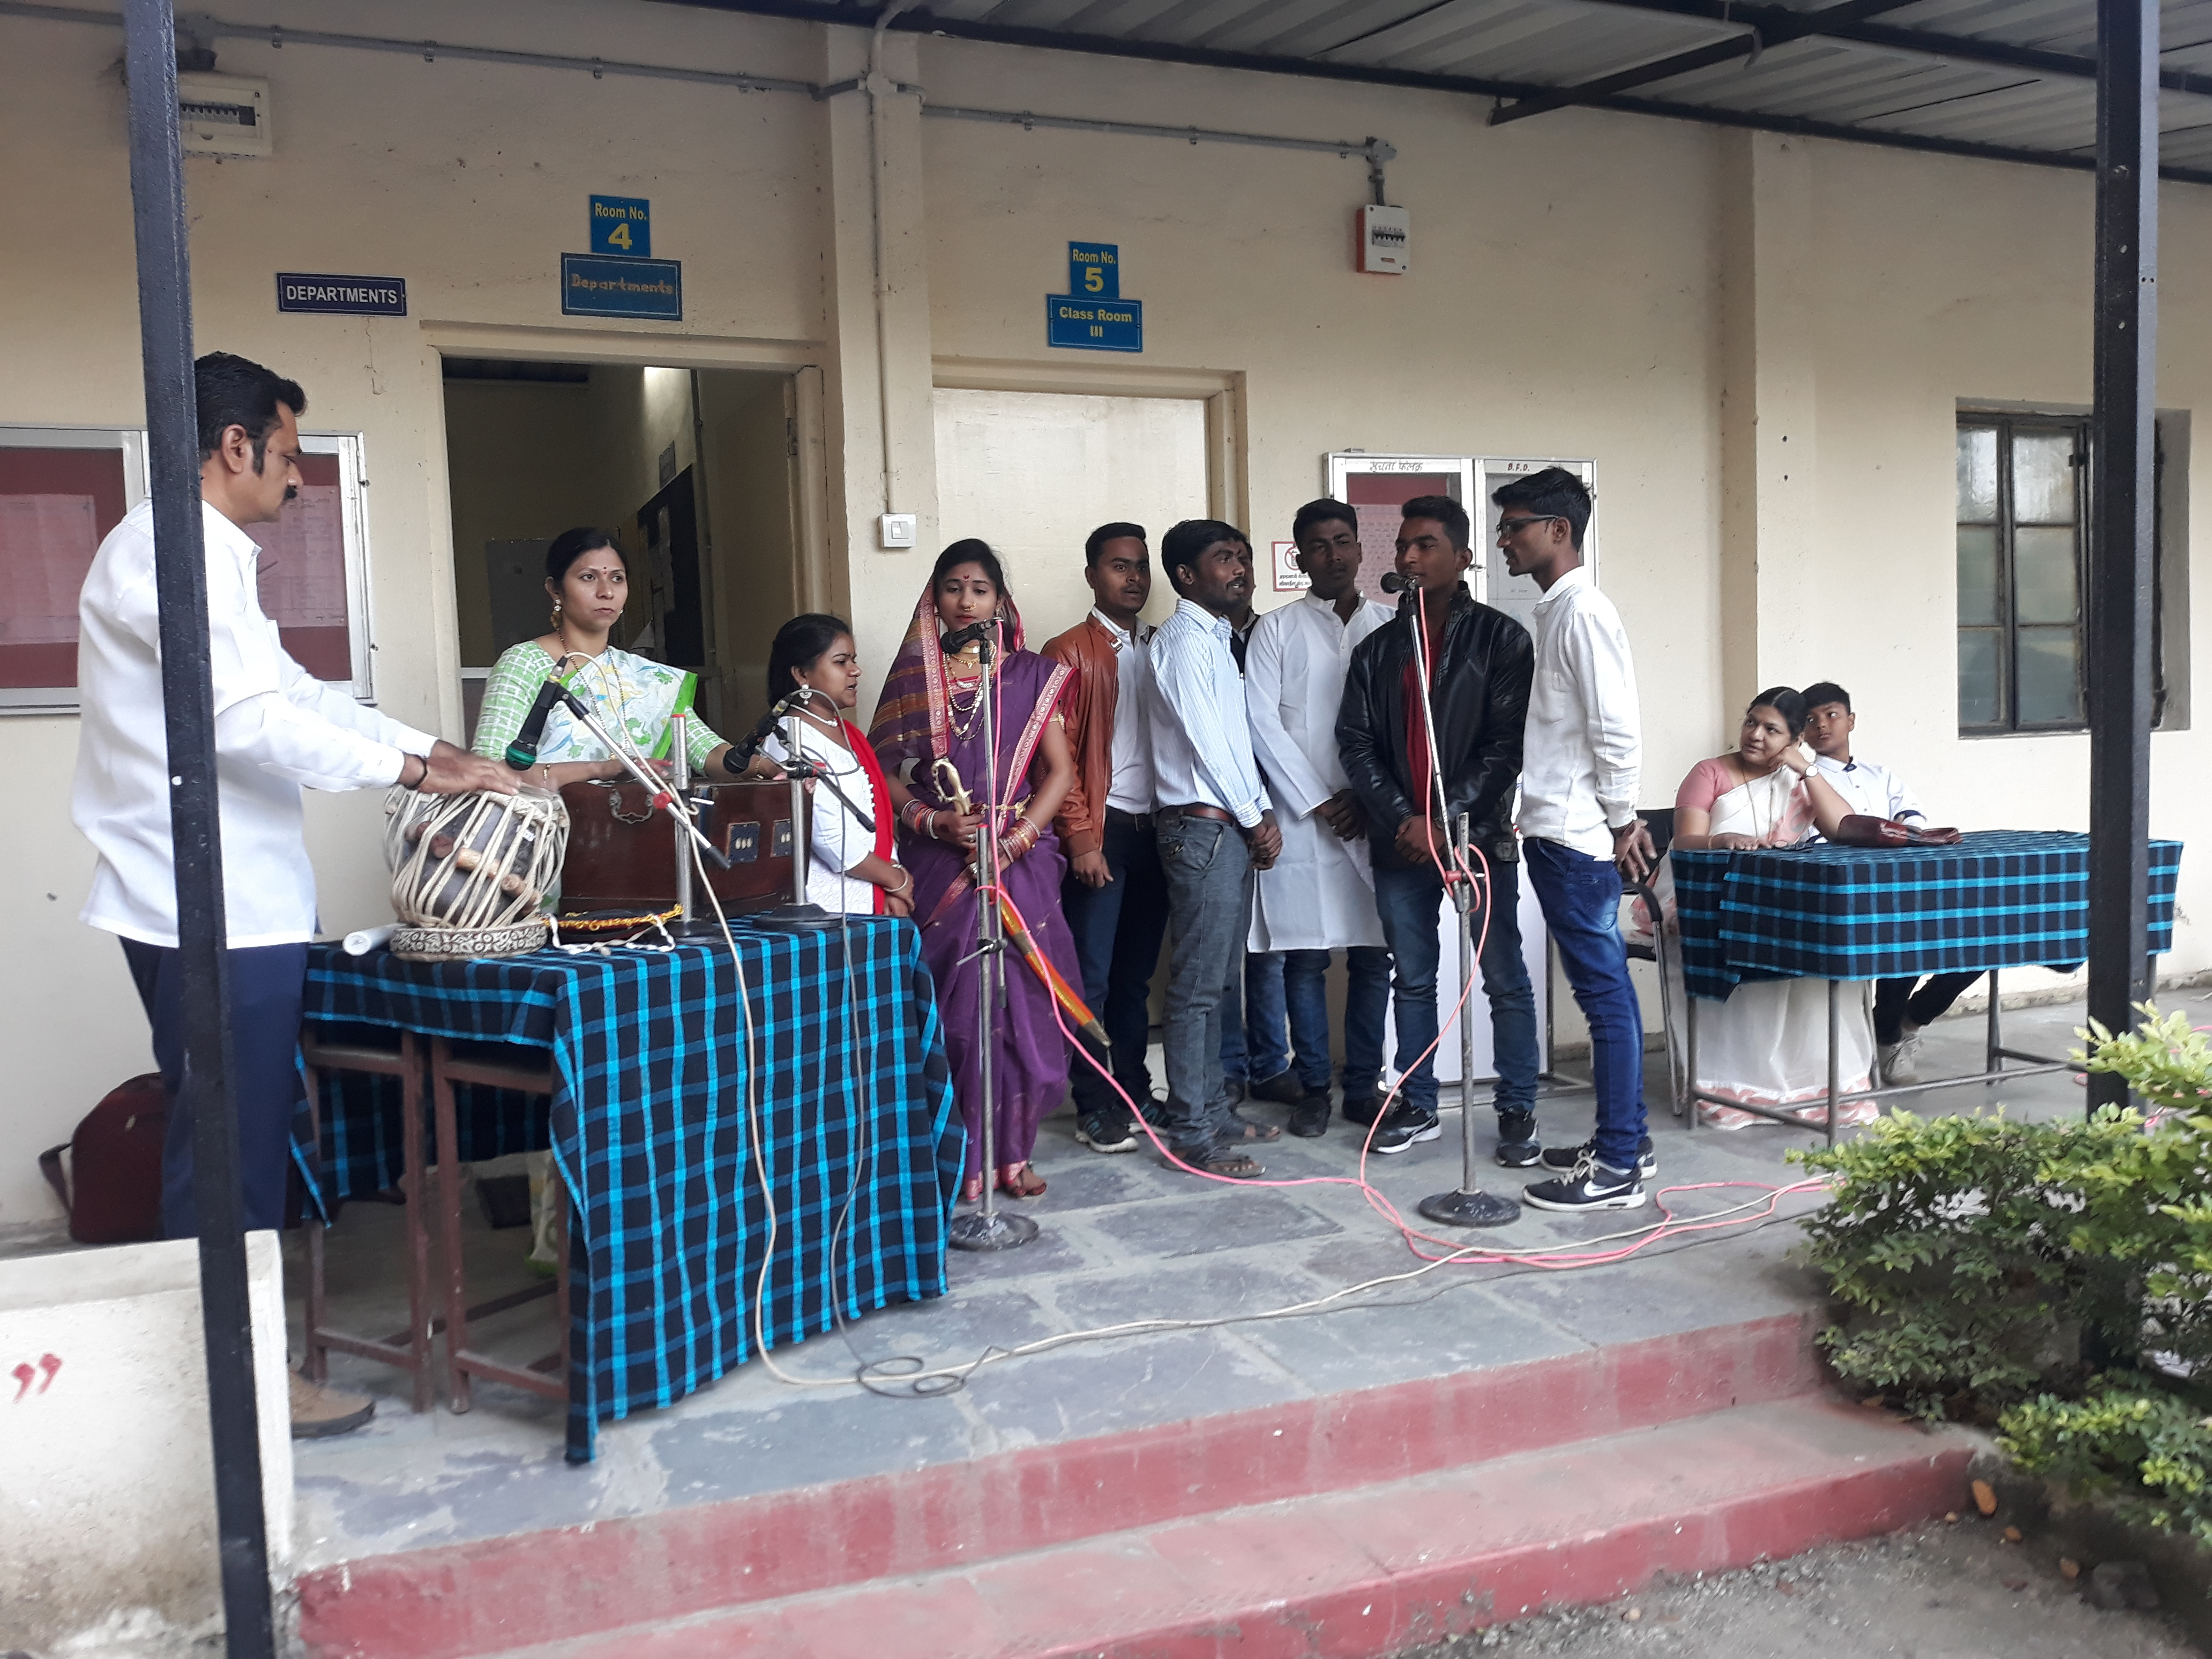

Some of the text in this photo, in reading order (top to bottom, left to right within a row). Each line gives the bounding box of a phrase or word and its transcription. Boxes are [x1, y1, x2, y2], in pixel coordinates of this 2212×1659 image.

[595, 203, 647, 220] Room No.
[608, 222, 633, 250] 4
[1073, 249, 1116, 264] Room No.
[571, 273, 673, 294] Departments
[1085, 267, 1104, 293] 5
[286, 285, 398, 304] DEPARTMENTS
[1059, 307, 1133, 322] Class Room
[1090, 325, 1104, 338] III
